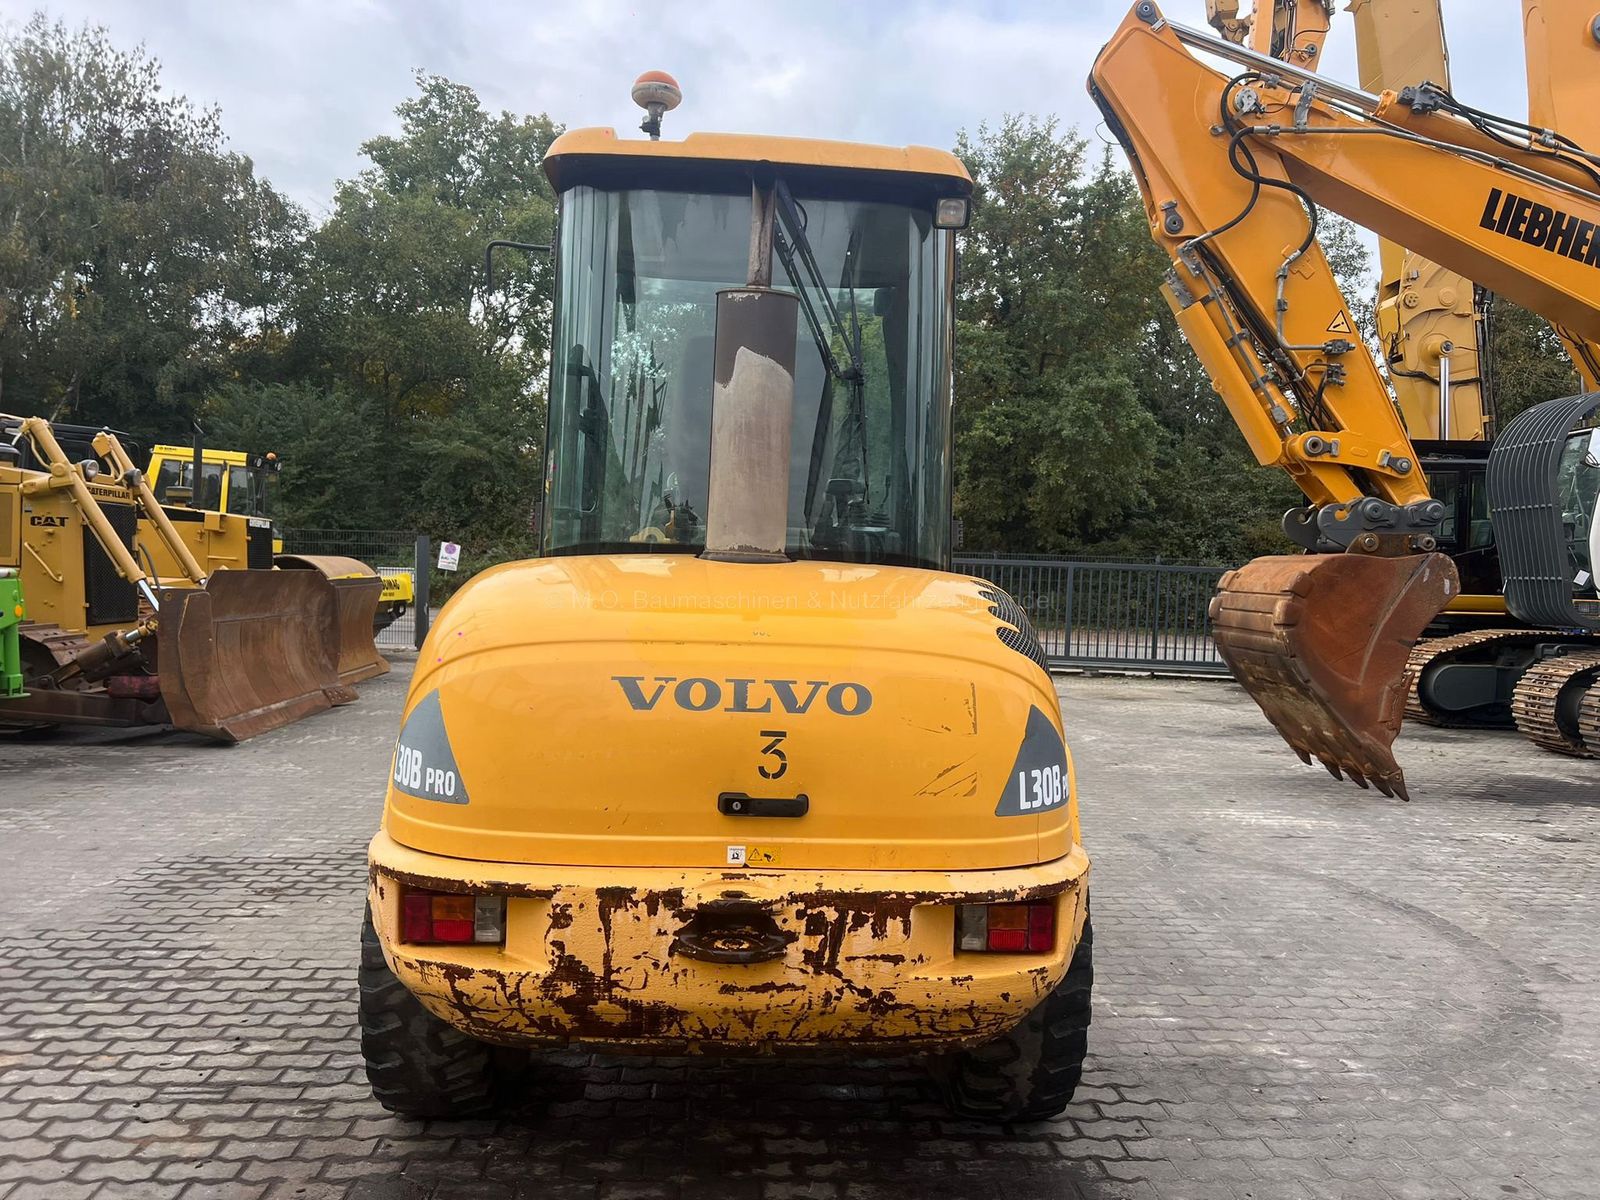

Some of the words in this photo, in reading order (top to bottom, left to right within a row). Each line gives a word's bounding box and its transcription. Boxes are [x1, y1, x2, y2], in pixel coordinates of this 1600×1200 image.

[30, 516, 69, 527] CAT
[610, 676, 873, 716] VOLVO
[758, 730, 788, 780] 3
[425, 767, 456, 797] PRO
[1019, 764, 1062, 810] L30B
